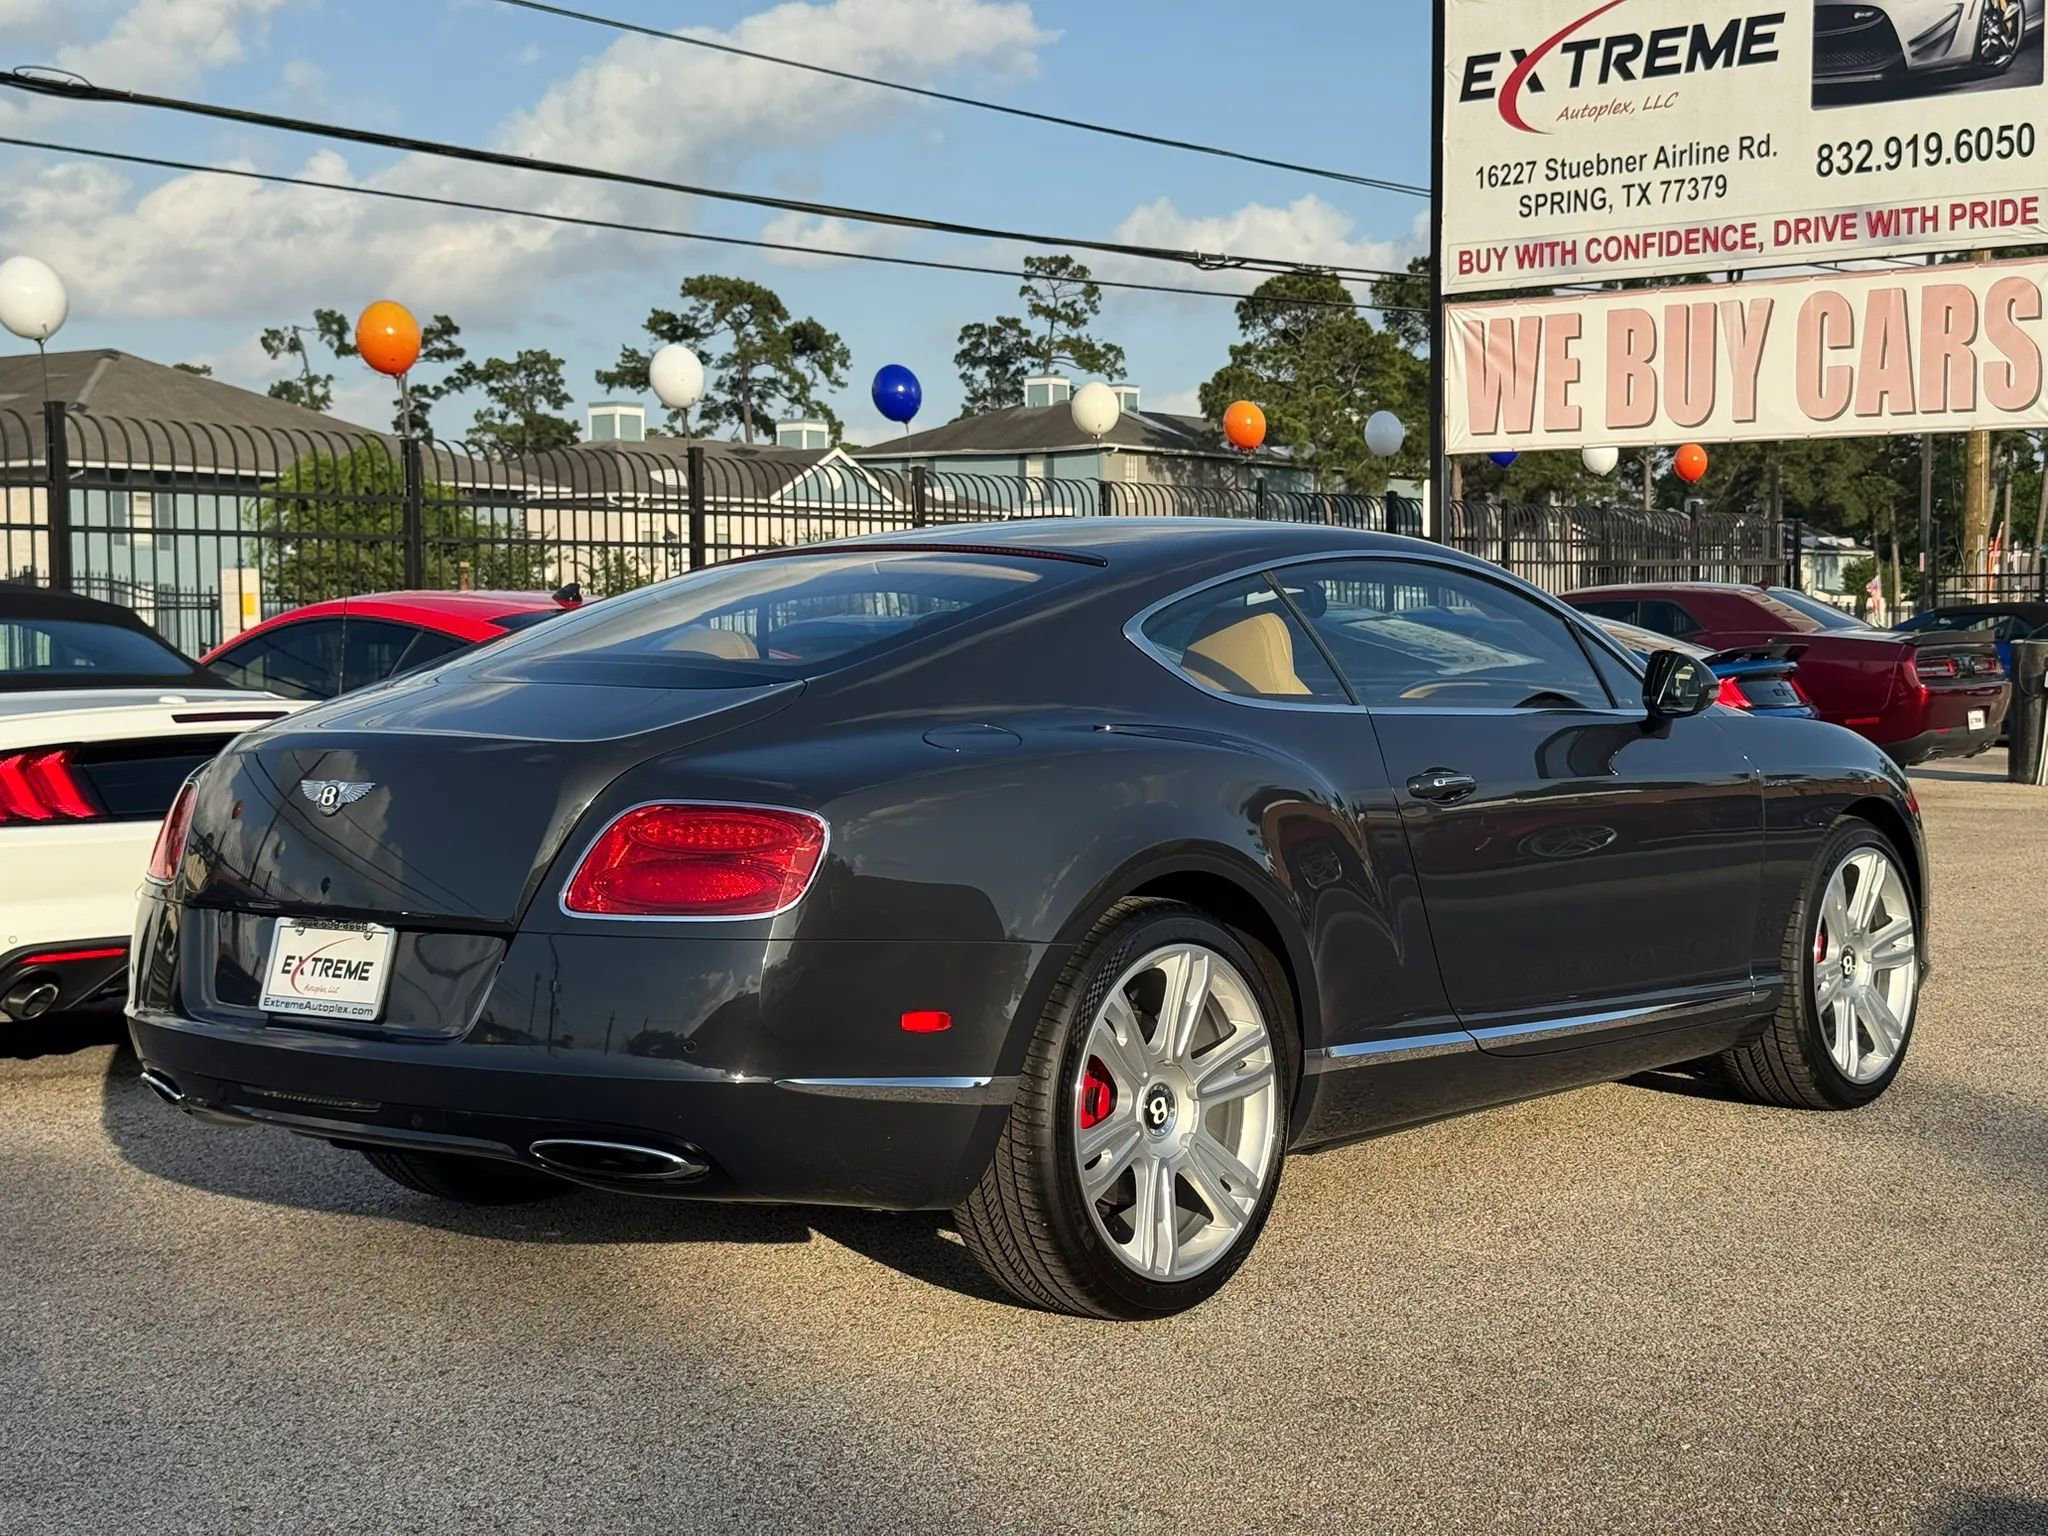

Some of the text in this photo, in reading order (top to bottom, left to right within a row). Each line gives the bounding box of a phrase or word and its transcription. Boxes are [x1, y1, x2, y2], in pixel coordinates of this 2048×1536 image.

[1459, 12, 1786, 103] EXTREME
[1556, 92, 1679, 123] Autoplex, LLC
[1475, 133, 1778, 190] 16227 Stuebner Airline Rd.
[1816, 122, 2036, 178] 832.919.6050
[1518, 174, 1728, 218] SPRING, TX 77379
[1458, 196, 2039, 275] BUY WITH CONFIDENCE, DRIVE WITH PRIDE
[1462, 276, 2043, 436] WE BUY CARS
[281, 955, 374, 982] EXTREME
[263, 997, 374, 1016] ExtremeAutoplex.com
